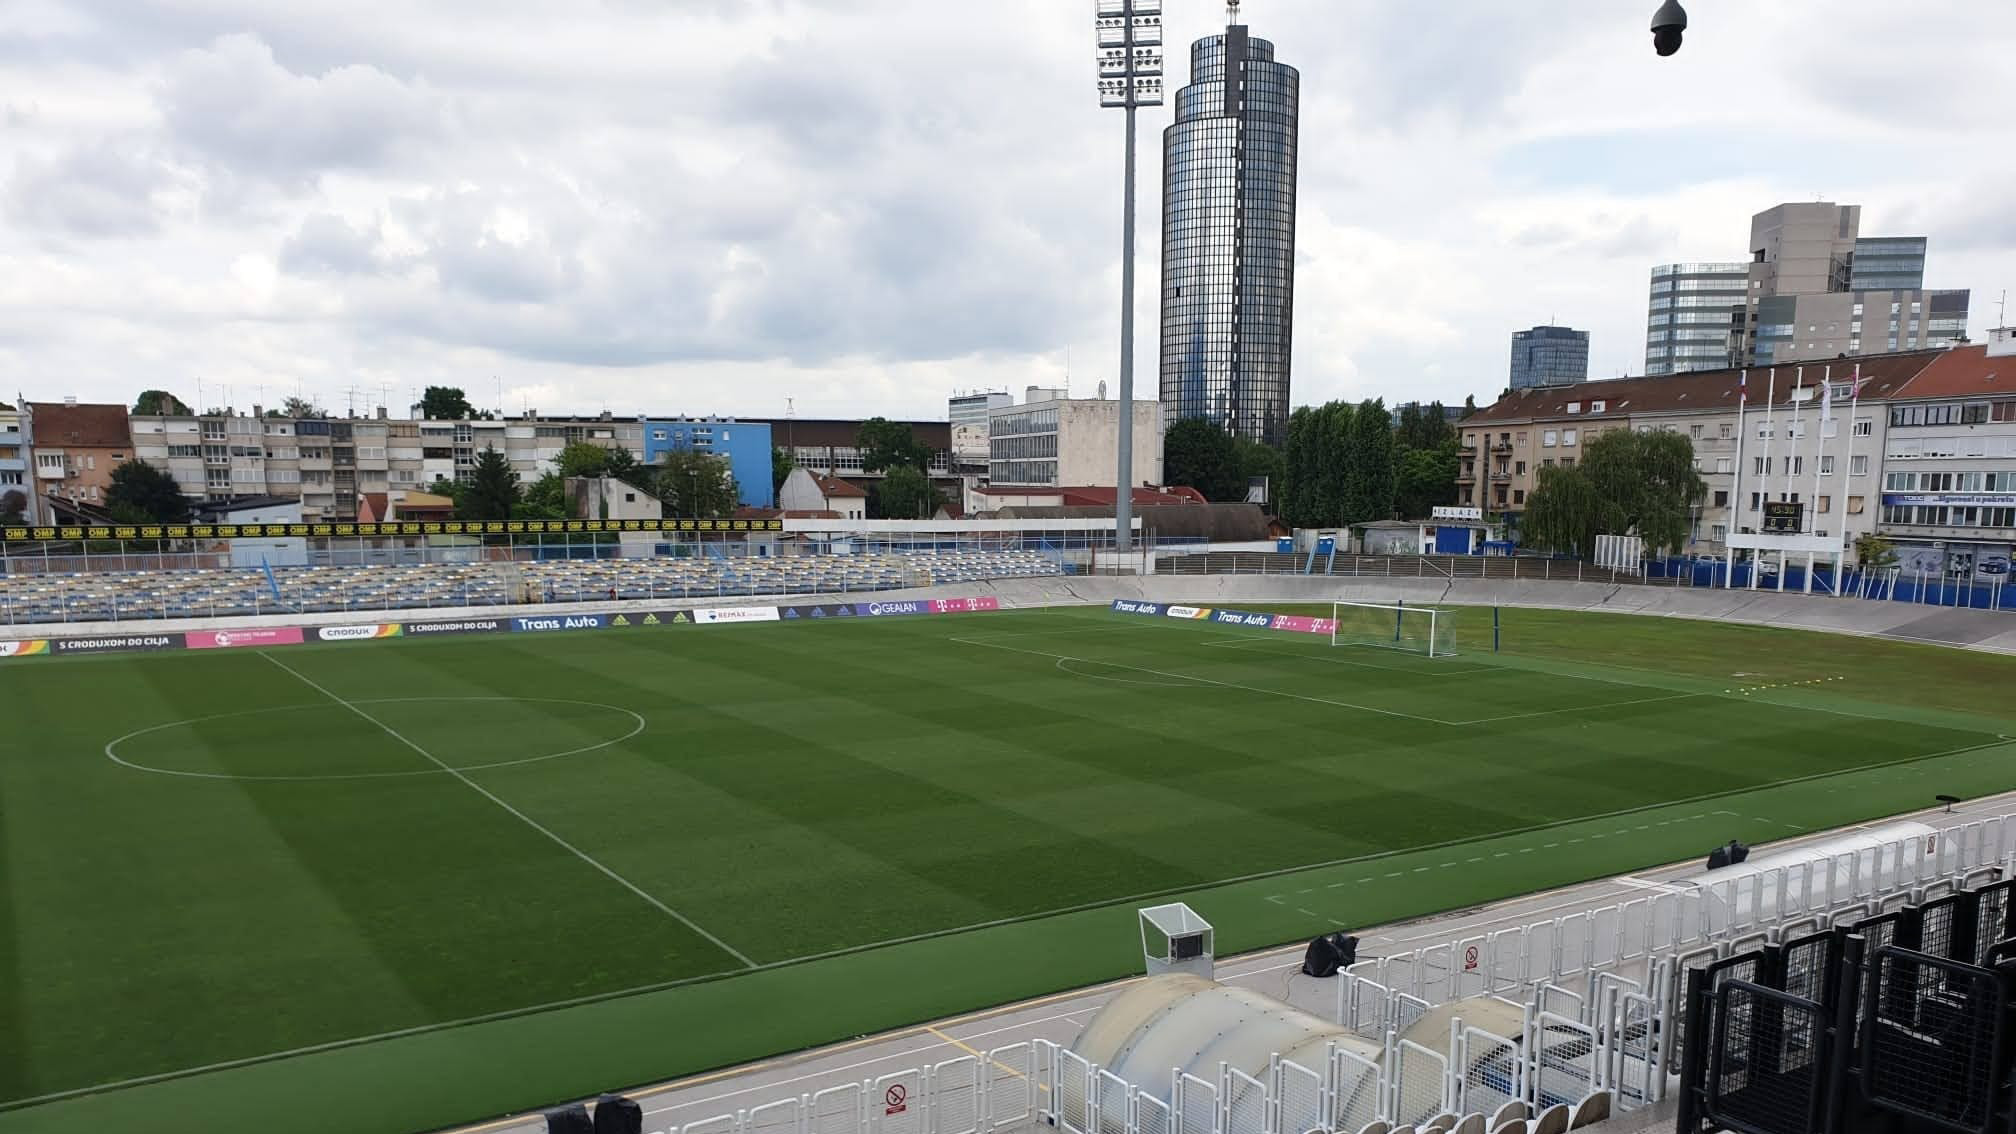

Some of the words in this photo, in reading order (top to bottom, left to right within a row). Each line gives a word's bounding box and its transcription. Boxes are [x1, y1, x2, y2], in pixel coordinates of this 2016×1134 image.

[5, 528, 27, 539] OMP
[34, 528, 55, 539] OMP
[62, 528, 82, 539] OMP
[88, 528, 110, 538] OMP
[115, 528, 136, 538] OMP
[142, 528, 161, 538] OMP
[169, 527, 188, 537] OMP
[193, 527, 212, 537] OMP
[218, 526, 236, 537] OMP
[243, 526, 261, 536] OMP
[267, 525, 285, 536] OMP
[291, 525, 308, 535] OMP
[314, 525, 331, 535] OMP
[336, 524, 353, 535] OMP
[359, 524, 376, 534] OMP
[1115, 600, 1137, 612] Trans
[1136, 602, 1156, 614] Auto
[518, 618, 560, 631] Trans
[565, 615, 598, 628] Auto
[1217, 611, 1243, 624] Trans
[1243, 614, 1268, 627] Auto
[409, 624, 416, 633] S
[464, 622, 476, 630] DO
[477, 621, 497, 630] CILJA
[59, 641, 66, 649] S
[68, 638, 126, 649] CRODUXOM
[128, 637, 142, 646] DO
[144, 636, 169, 646] CILJA
